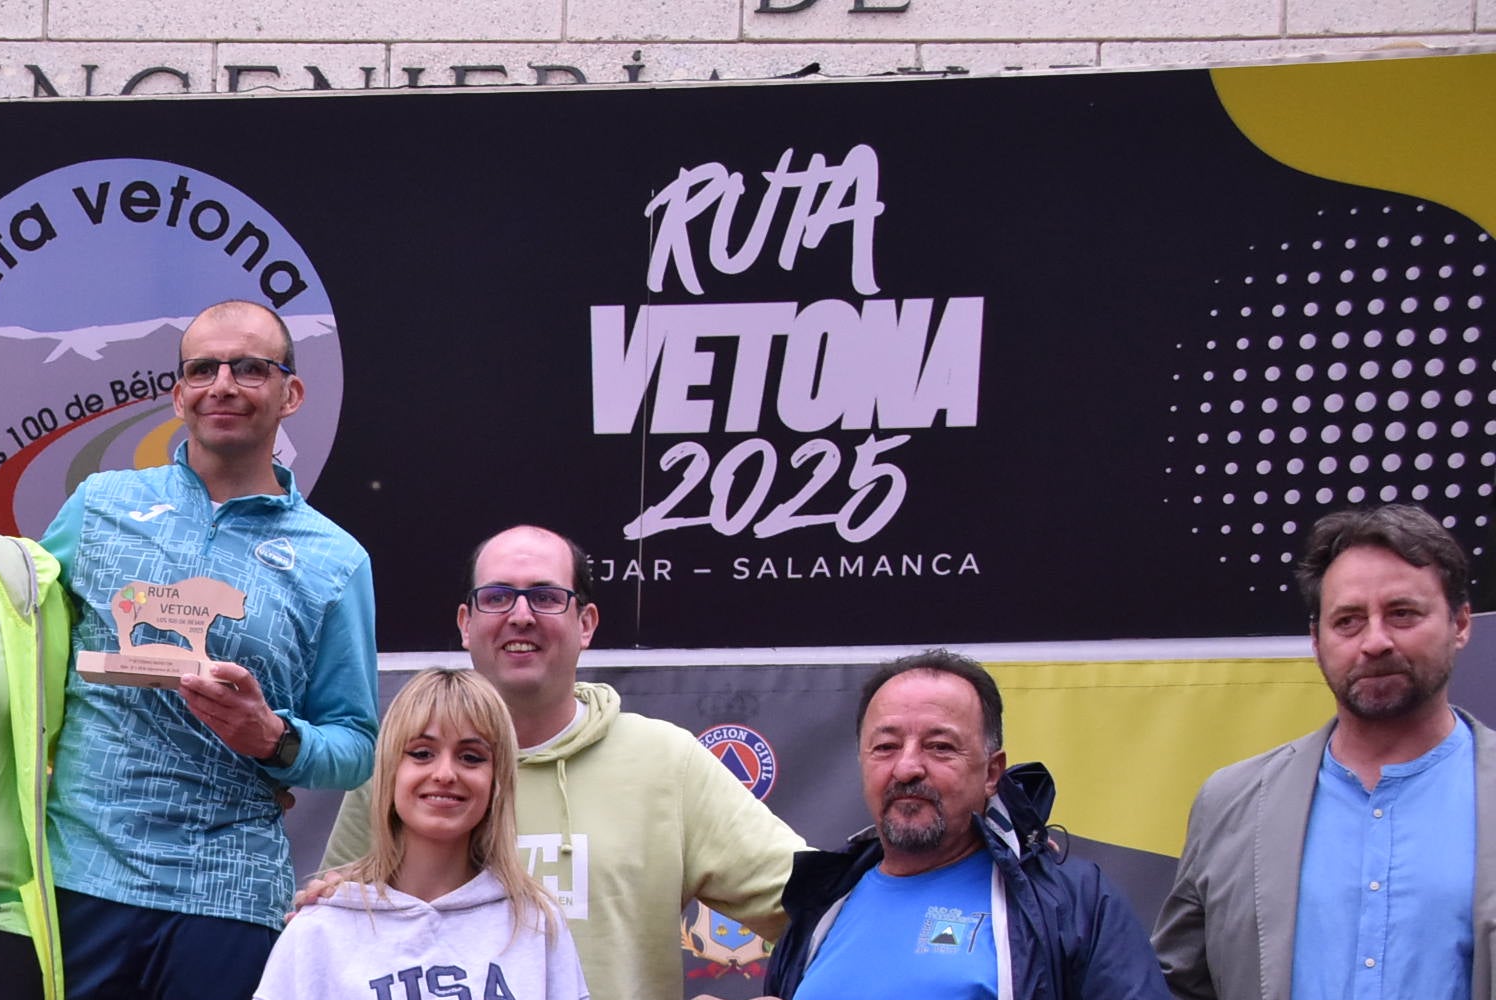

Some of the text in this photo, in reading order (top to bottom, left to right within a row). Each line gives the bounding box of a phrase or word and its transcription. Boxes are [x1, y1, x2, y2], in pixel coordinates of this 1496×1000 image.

[71, 175, 309, 310] vetona
[644, 143, 886, 296] RUTA
[589, 296, 985, 434] VETONA
[6, 406, 59, 450] 100
[64, 393, 104, 423] de
[110, 370, 182, 407] Béja
[622, 433, 912, 544] 2025
[147, 586, 180, 599] RUTA
[732, 552, 982, 580] SALAMANCA
[160, 603, 210, 617] VETONA
[753, 741, 773, 781] CIVIL
